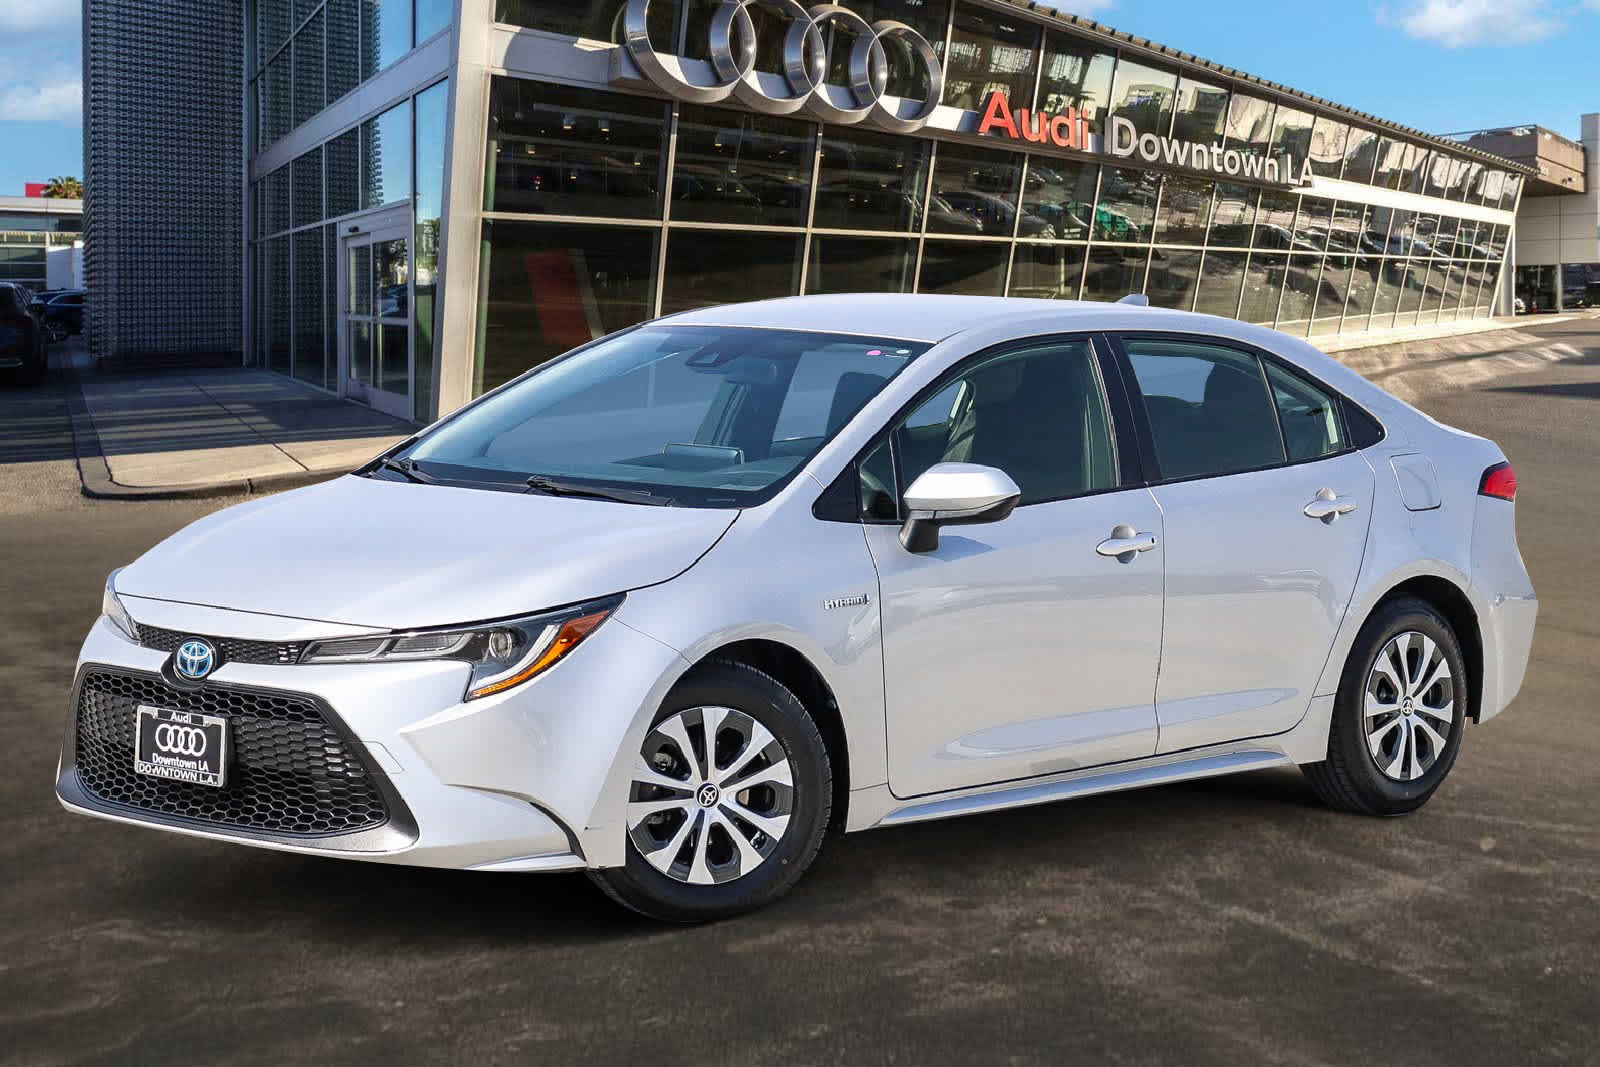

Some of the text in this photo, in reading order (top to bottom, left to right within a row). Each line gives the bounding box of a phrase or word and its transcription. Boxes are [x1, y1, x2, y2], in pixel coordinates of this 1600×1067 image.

[978, 91, 1315, 188] Audi Downtown LA
[824, 595, 867, 609] HYBRID
[170, 711, 191, 724] Audi
[152, 753, 209, 771] Downtown LA
[139, 763, 218, 784] DOWNTOWN L.A.
